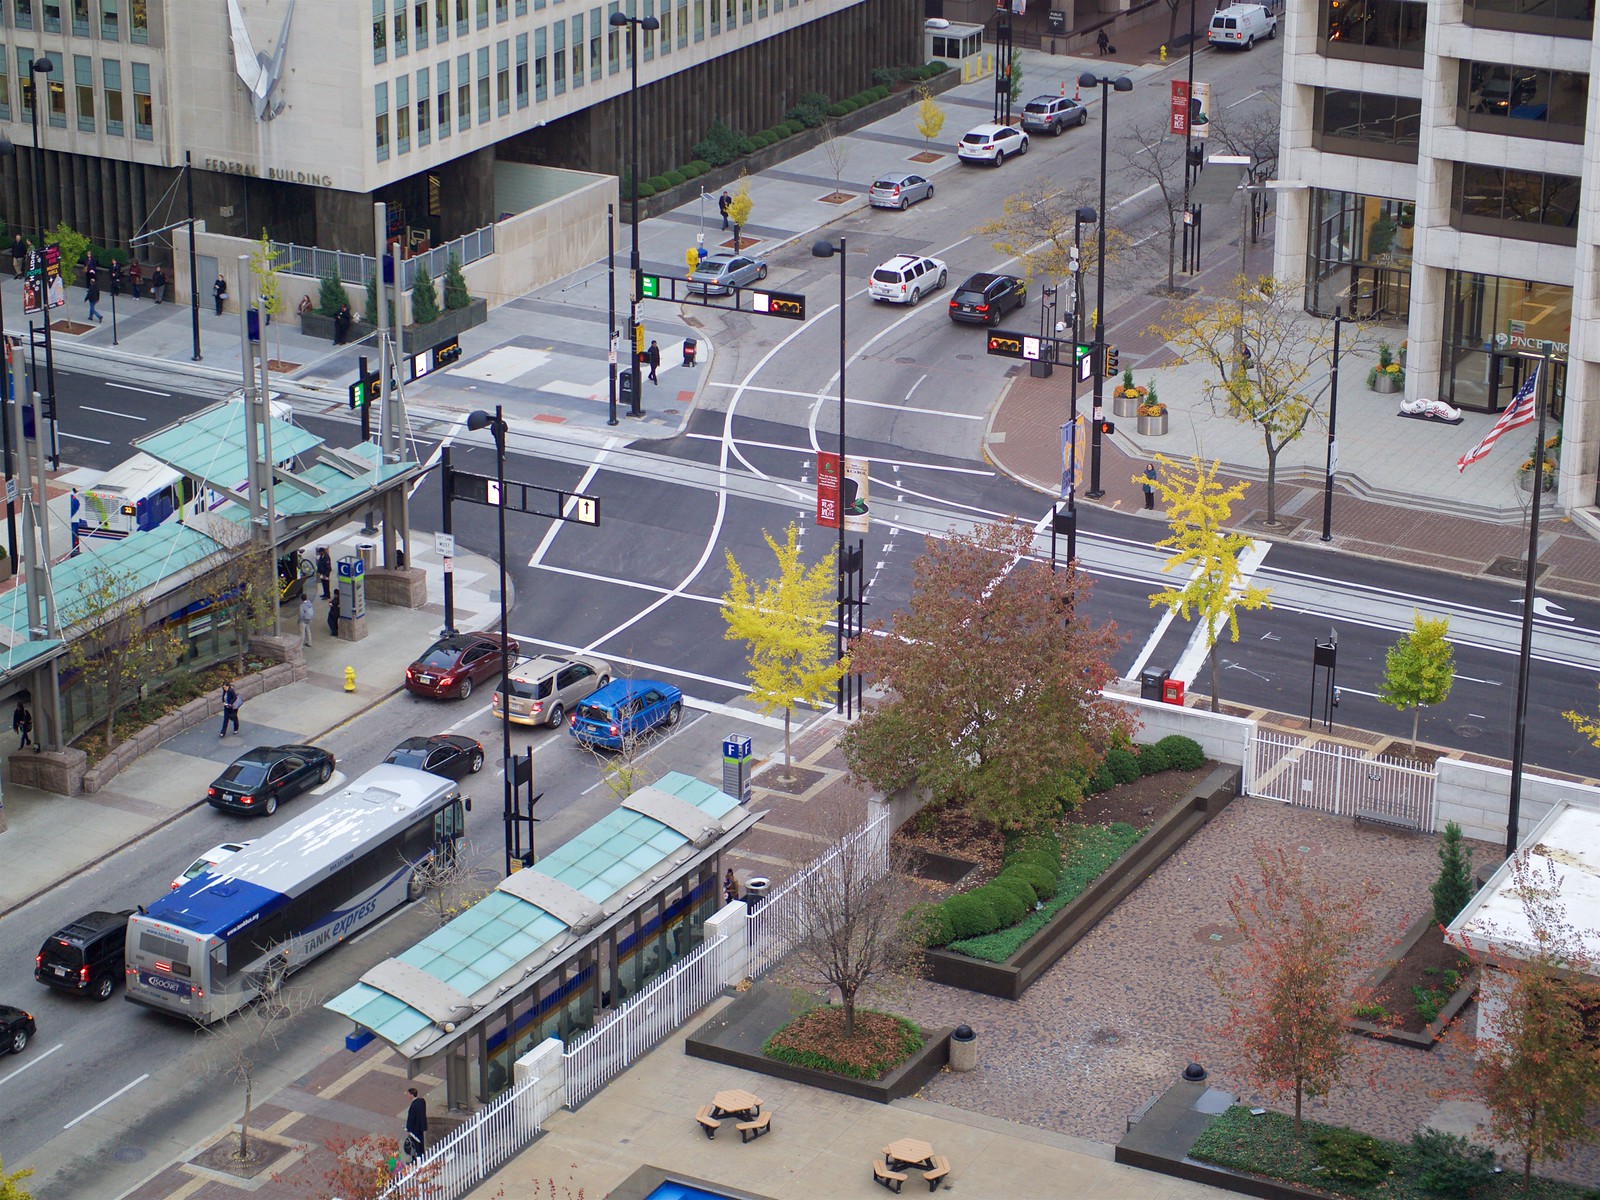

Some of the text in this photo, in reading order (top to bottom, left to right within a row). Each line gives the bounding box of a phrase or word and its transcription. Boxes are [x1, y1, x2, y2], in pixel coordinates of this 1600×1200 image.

[205, 158, 332, 187] FEDERAL BUILDING
[26, 267, 42, 278] POPS
[1510, 335, 1568, 353] PNC BNK
[340, 564, 349, 575] C
[356, 562, 362, 574] C
[728, 744, 735, 756] F
[745, 742, 750, 755] F
[304, 898, 377, 954] TANK express
[146, 928, 185, 944] www.tankbus.org
